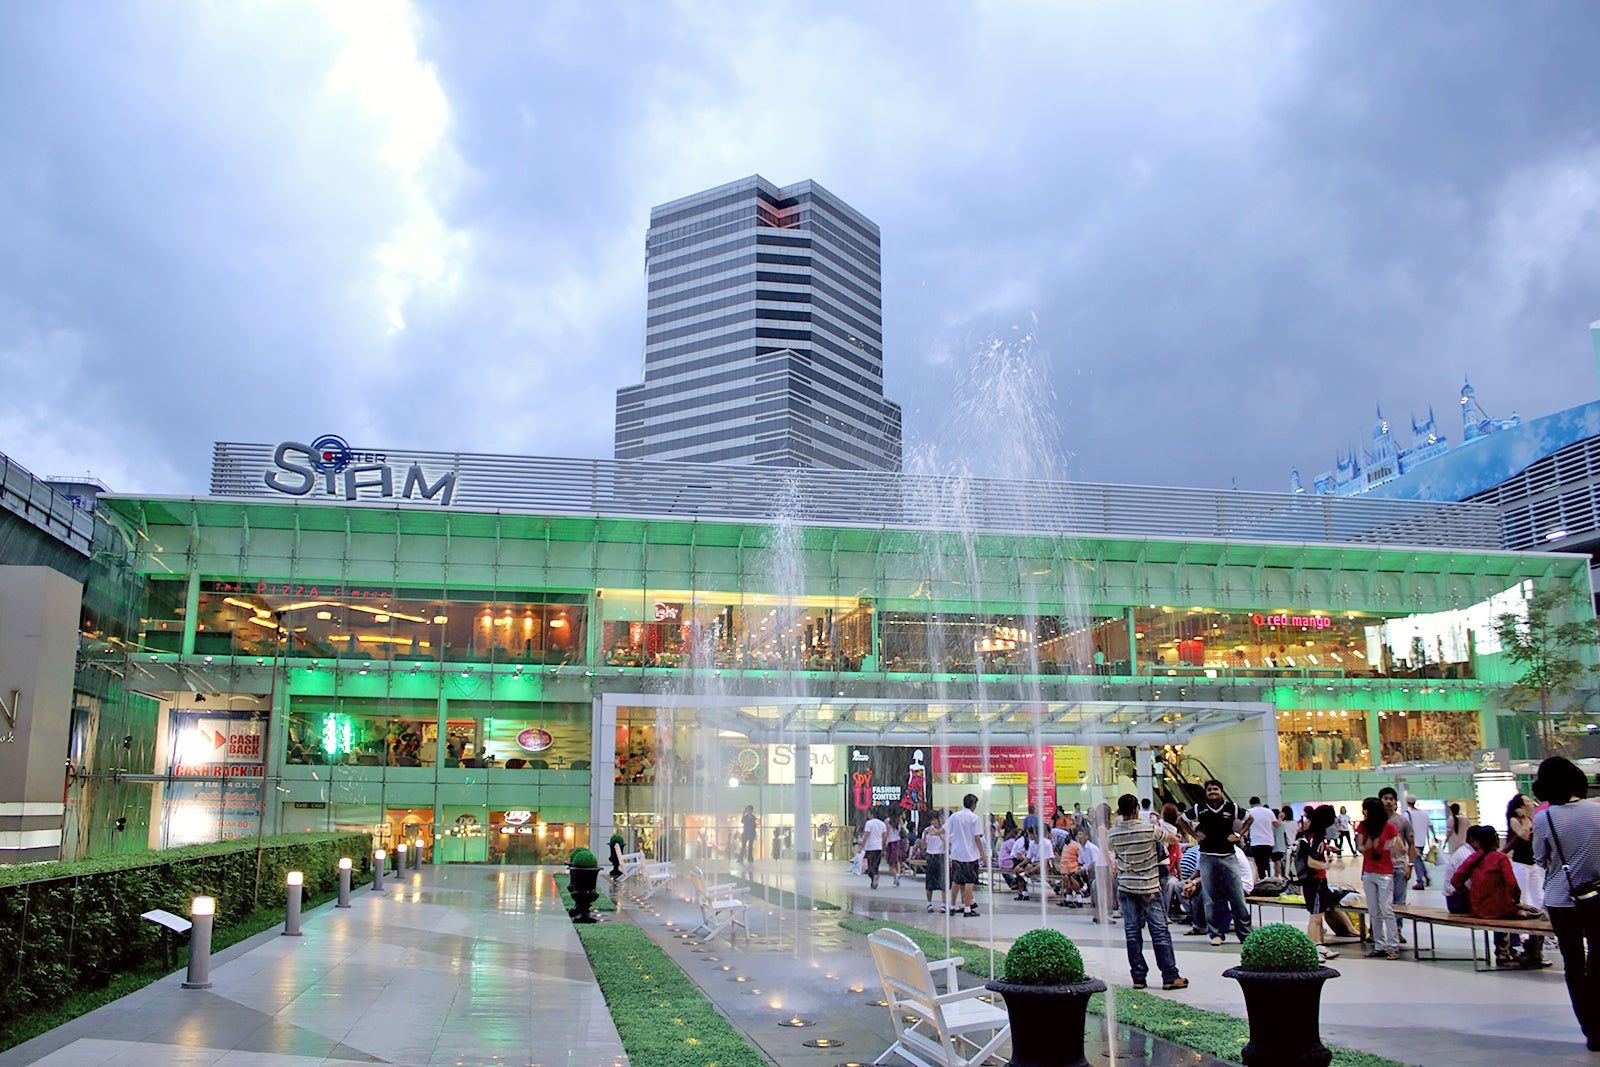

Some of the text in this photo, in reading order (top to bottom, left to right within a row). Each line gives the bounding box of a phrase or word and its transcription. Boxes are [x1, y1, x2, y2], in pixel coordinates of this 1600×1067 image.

[1291, 616, 1331, 630] mango
[230, 734, 260, 745] CASH
[229, 744, 260, 755] BACK
[175, 765, 210, 777] CASH
[213, 766, 248, 777] BACK
